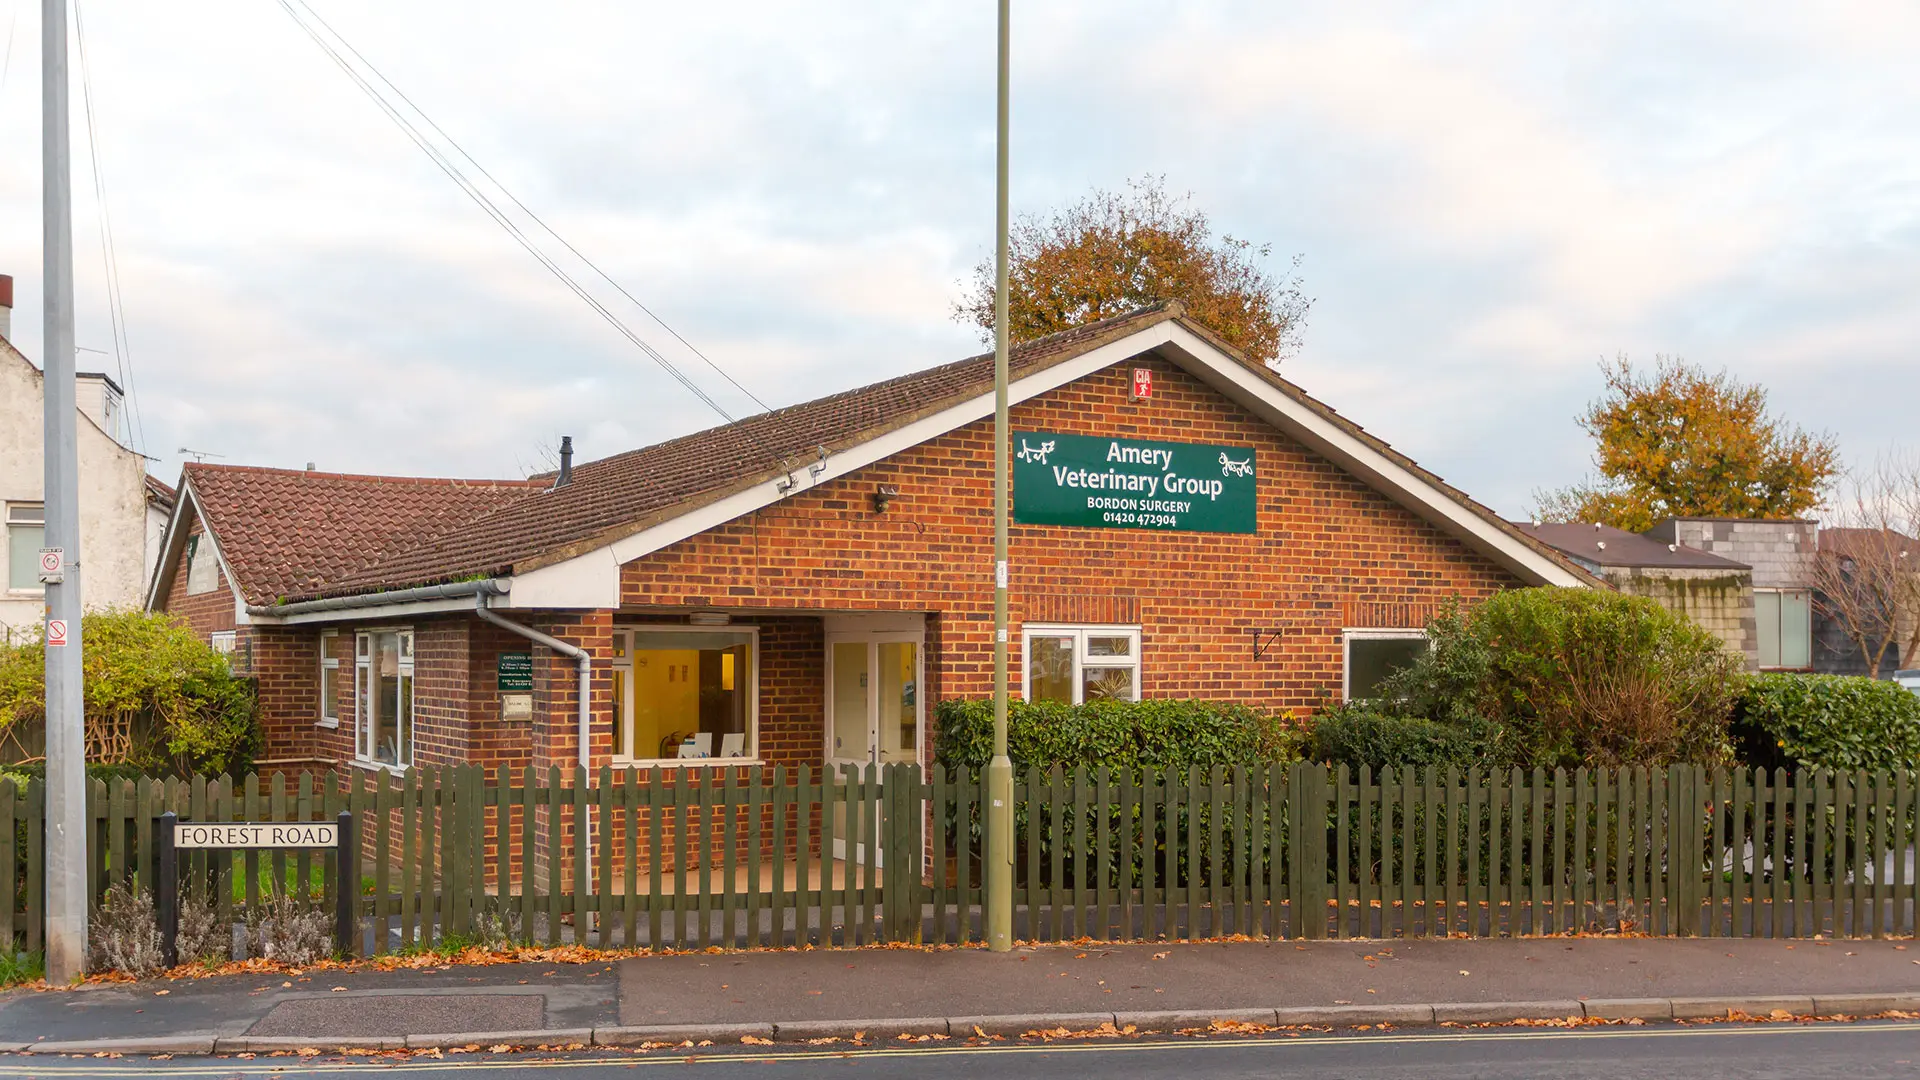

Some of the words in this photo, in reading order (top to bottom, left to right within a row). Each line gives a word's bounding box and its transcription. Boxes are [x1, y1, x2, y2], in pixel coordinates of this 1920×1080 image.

[1136, 370, 1150, 384] CIA
[1106, 442, 1172, 471] Amery
[1053, 466, 1158, 497] Veterinary
[1163, 473, 1223, 501] Group
[1087, 497, 1137, 511] BORDON
[1139, 499, 1191, 513] SURGERY
[1103, 512, 1135, 524] 01420
[1137, 514, 1176, 527] 472904
[181, 827, 263, 844] FOREST
[272, 827, 332, 844] ROAD
